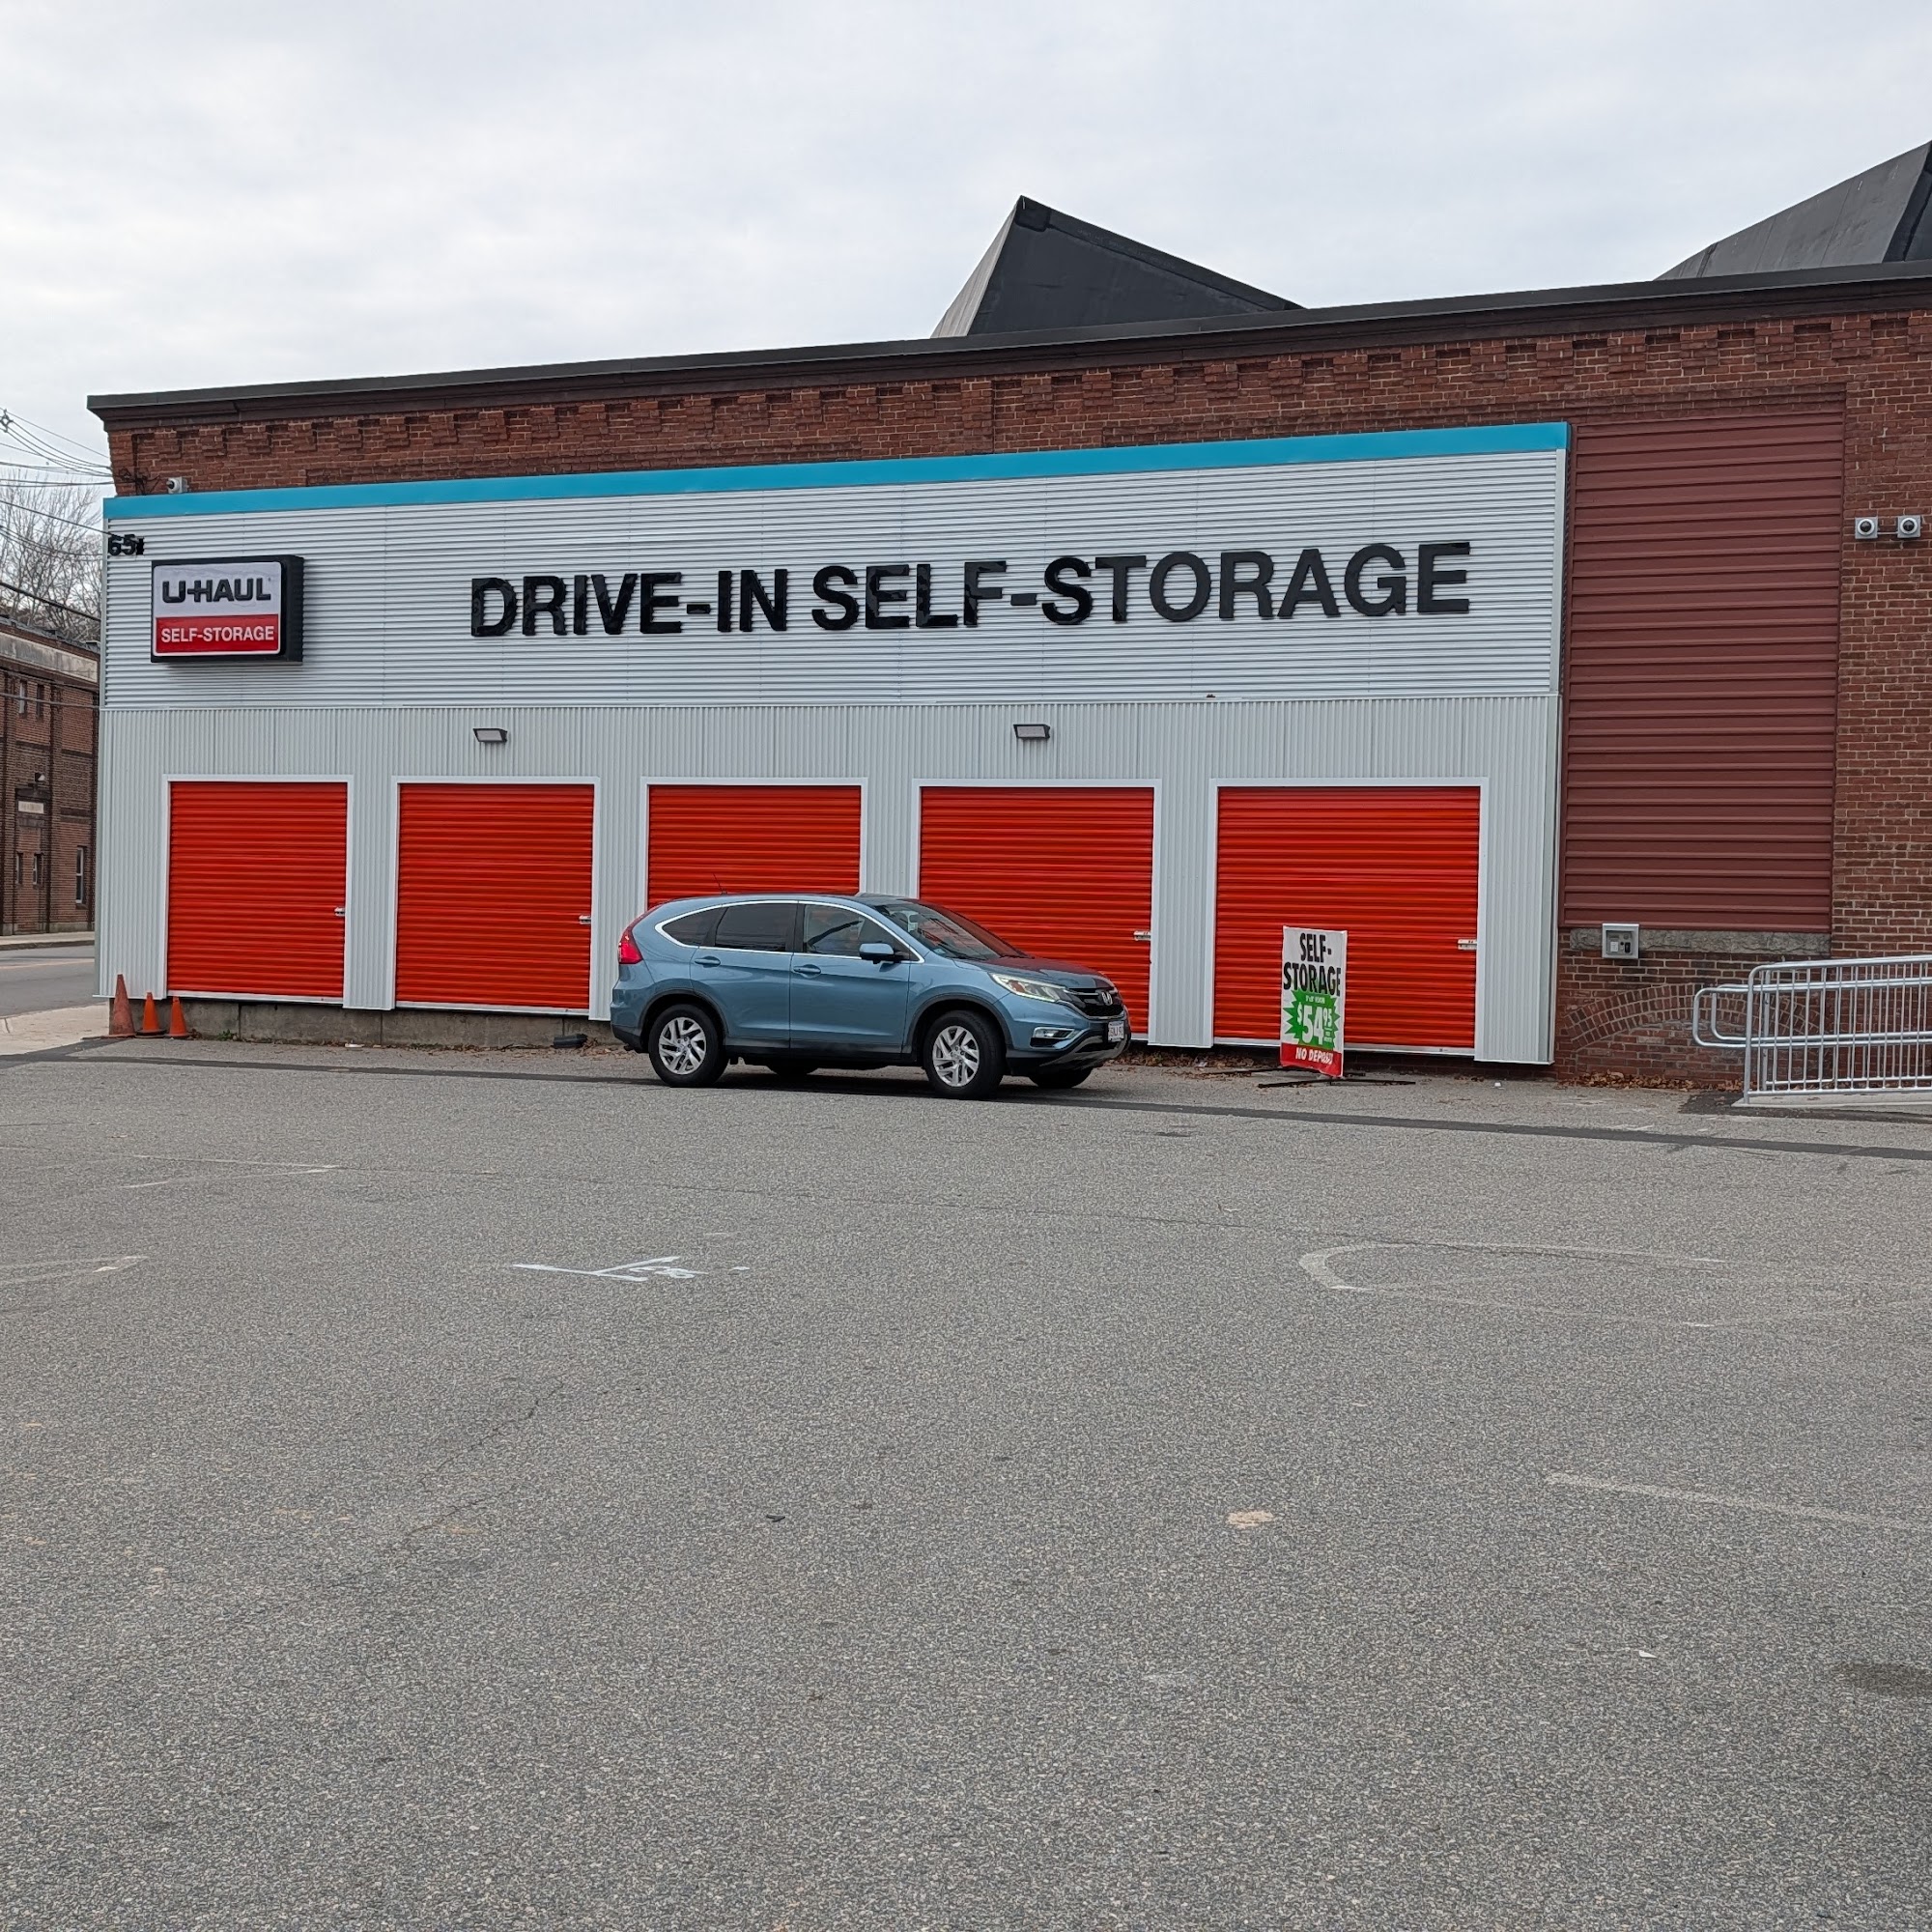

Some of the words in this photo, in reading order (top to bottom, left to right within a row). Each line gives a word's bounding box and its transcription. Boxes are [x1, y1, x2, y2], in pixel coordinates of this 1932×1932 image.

[162, 578, 271, 604] U-HAUL
[471, 569, 788, 637] DRIVE-IN
[811, 542, 1470, 631] SELF-STORAGE
[161, 626, 274, 642] SELF-STORAGE
[1299, 932, 1332, 963] SELF-
[1283, 961, 1342, 997] STORAGE
[1295, 1046, 1307, 1061] NO
